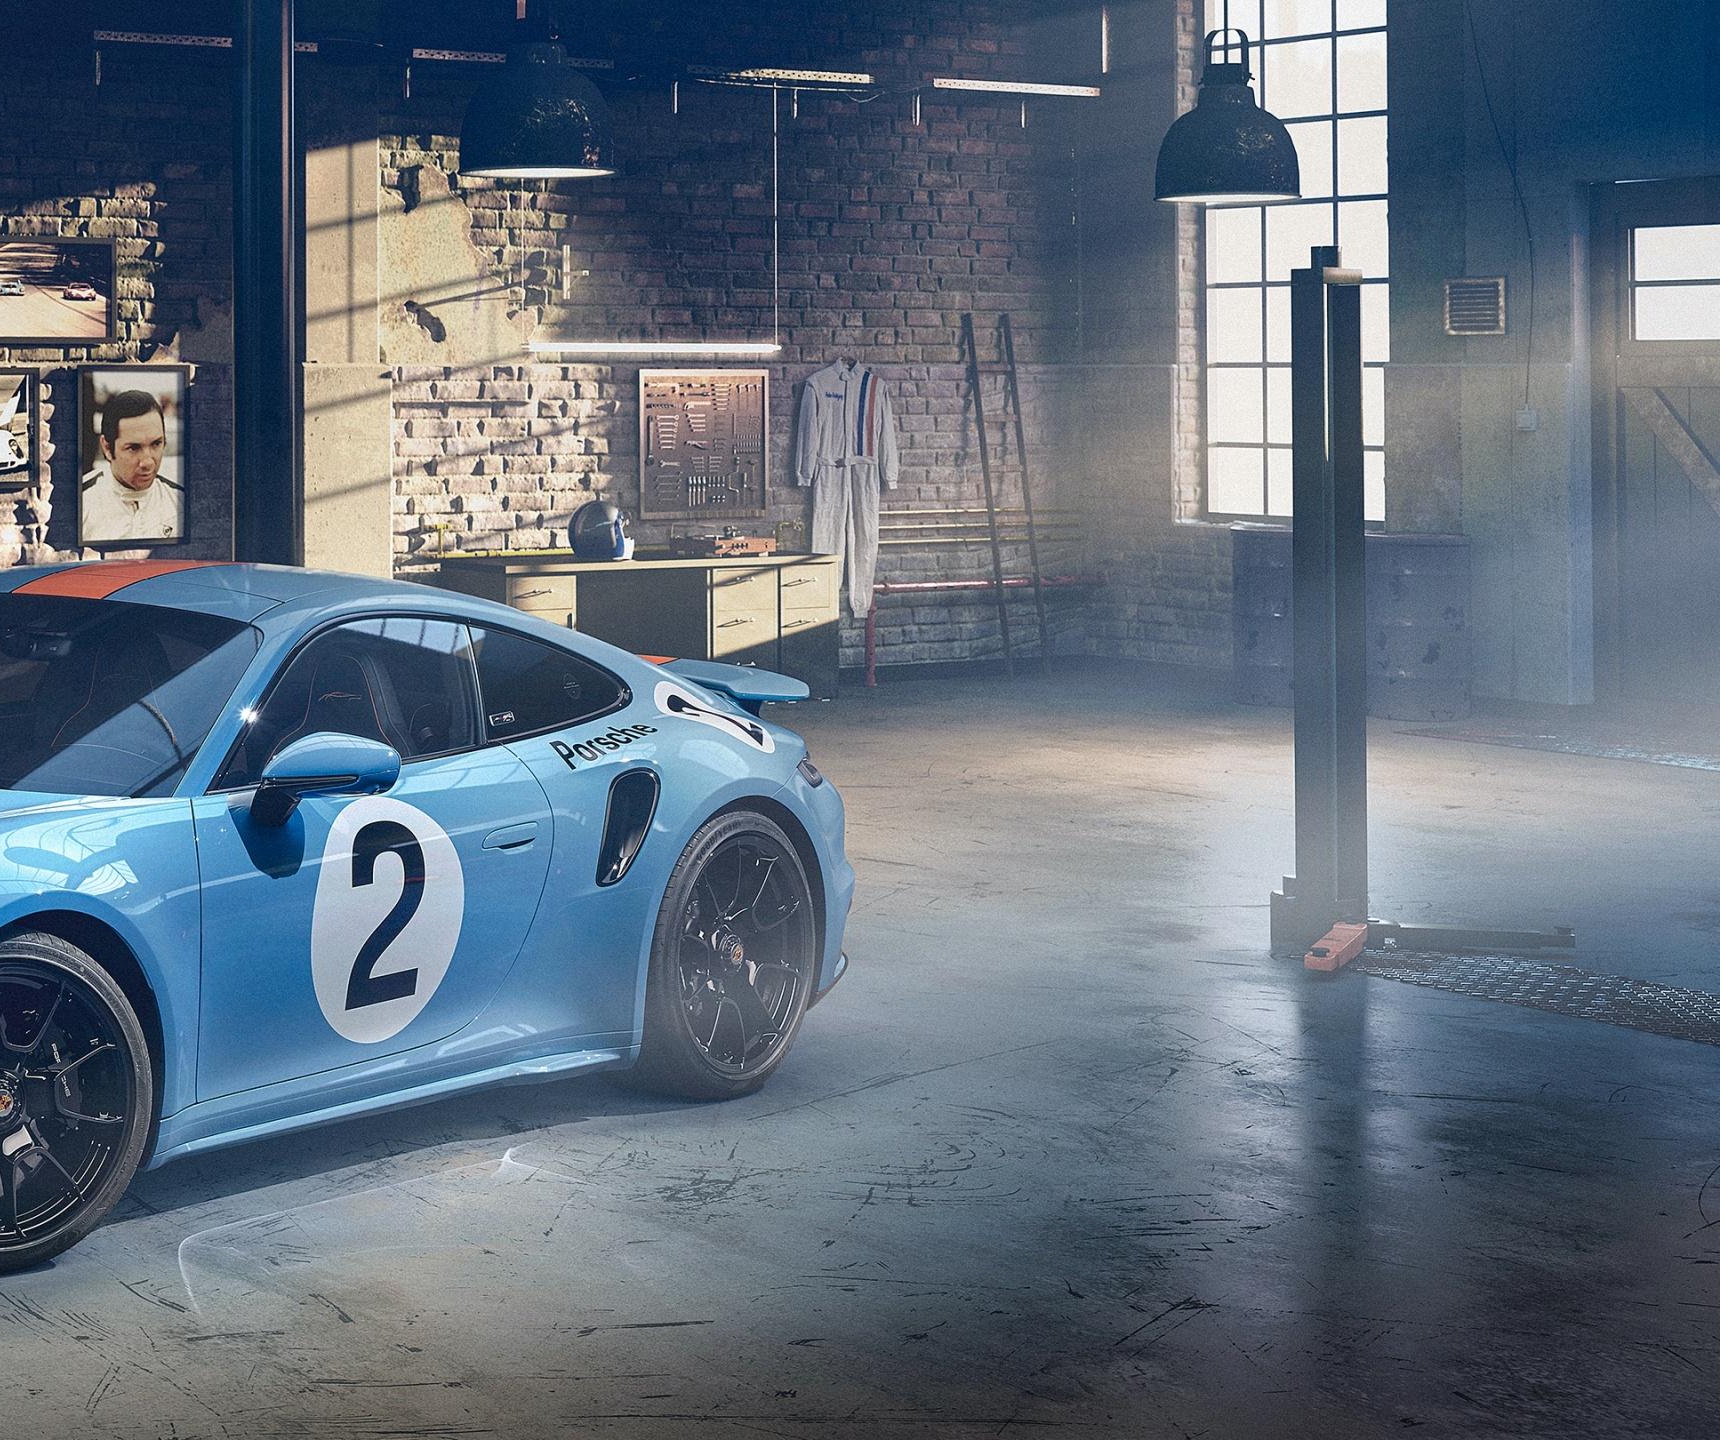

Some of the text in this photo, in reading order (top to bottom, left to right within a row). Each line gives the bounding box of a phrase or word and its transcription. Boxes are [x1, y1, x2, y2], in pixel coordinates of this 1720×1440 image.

[667, 694, 764, 747] 2
[549, 724, 658, 771] Porsche
[345, 820, 426, 1011] 2
